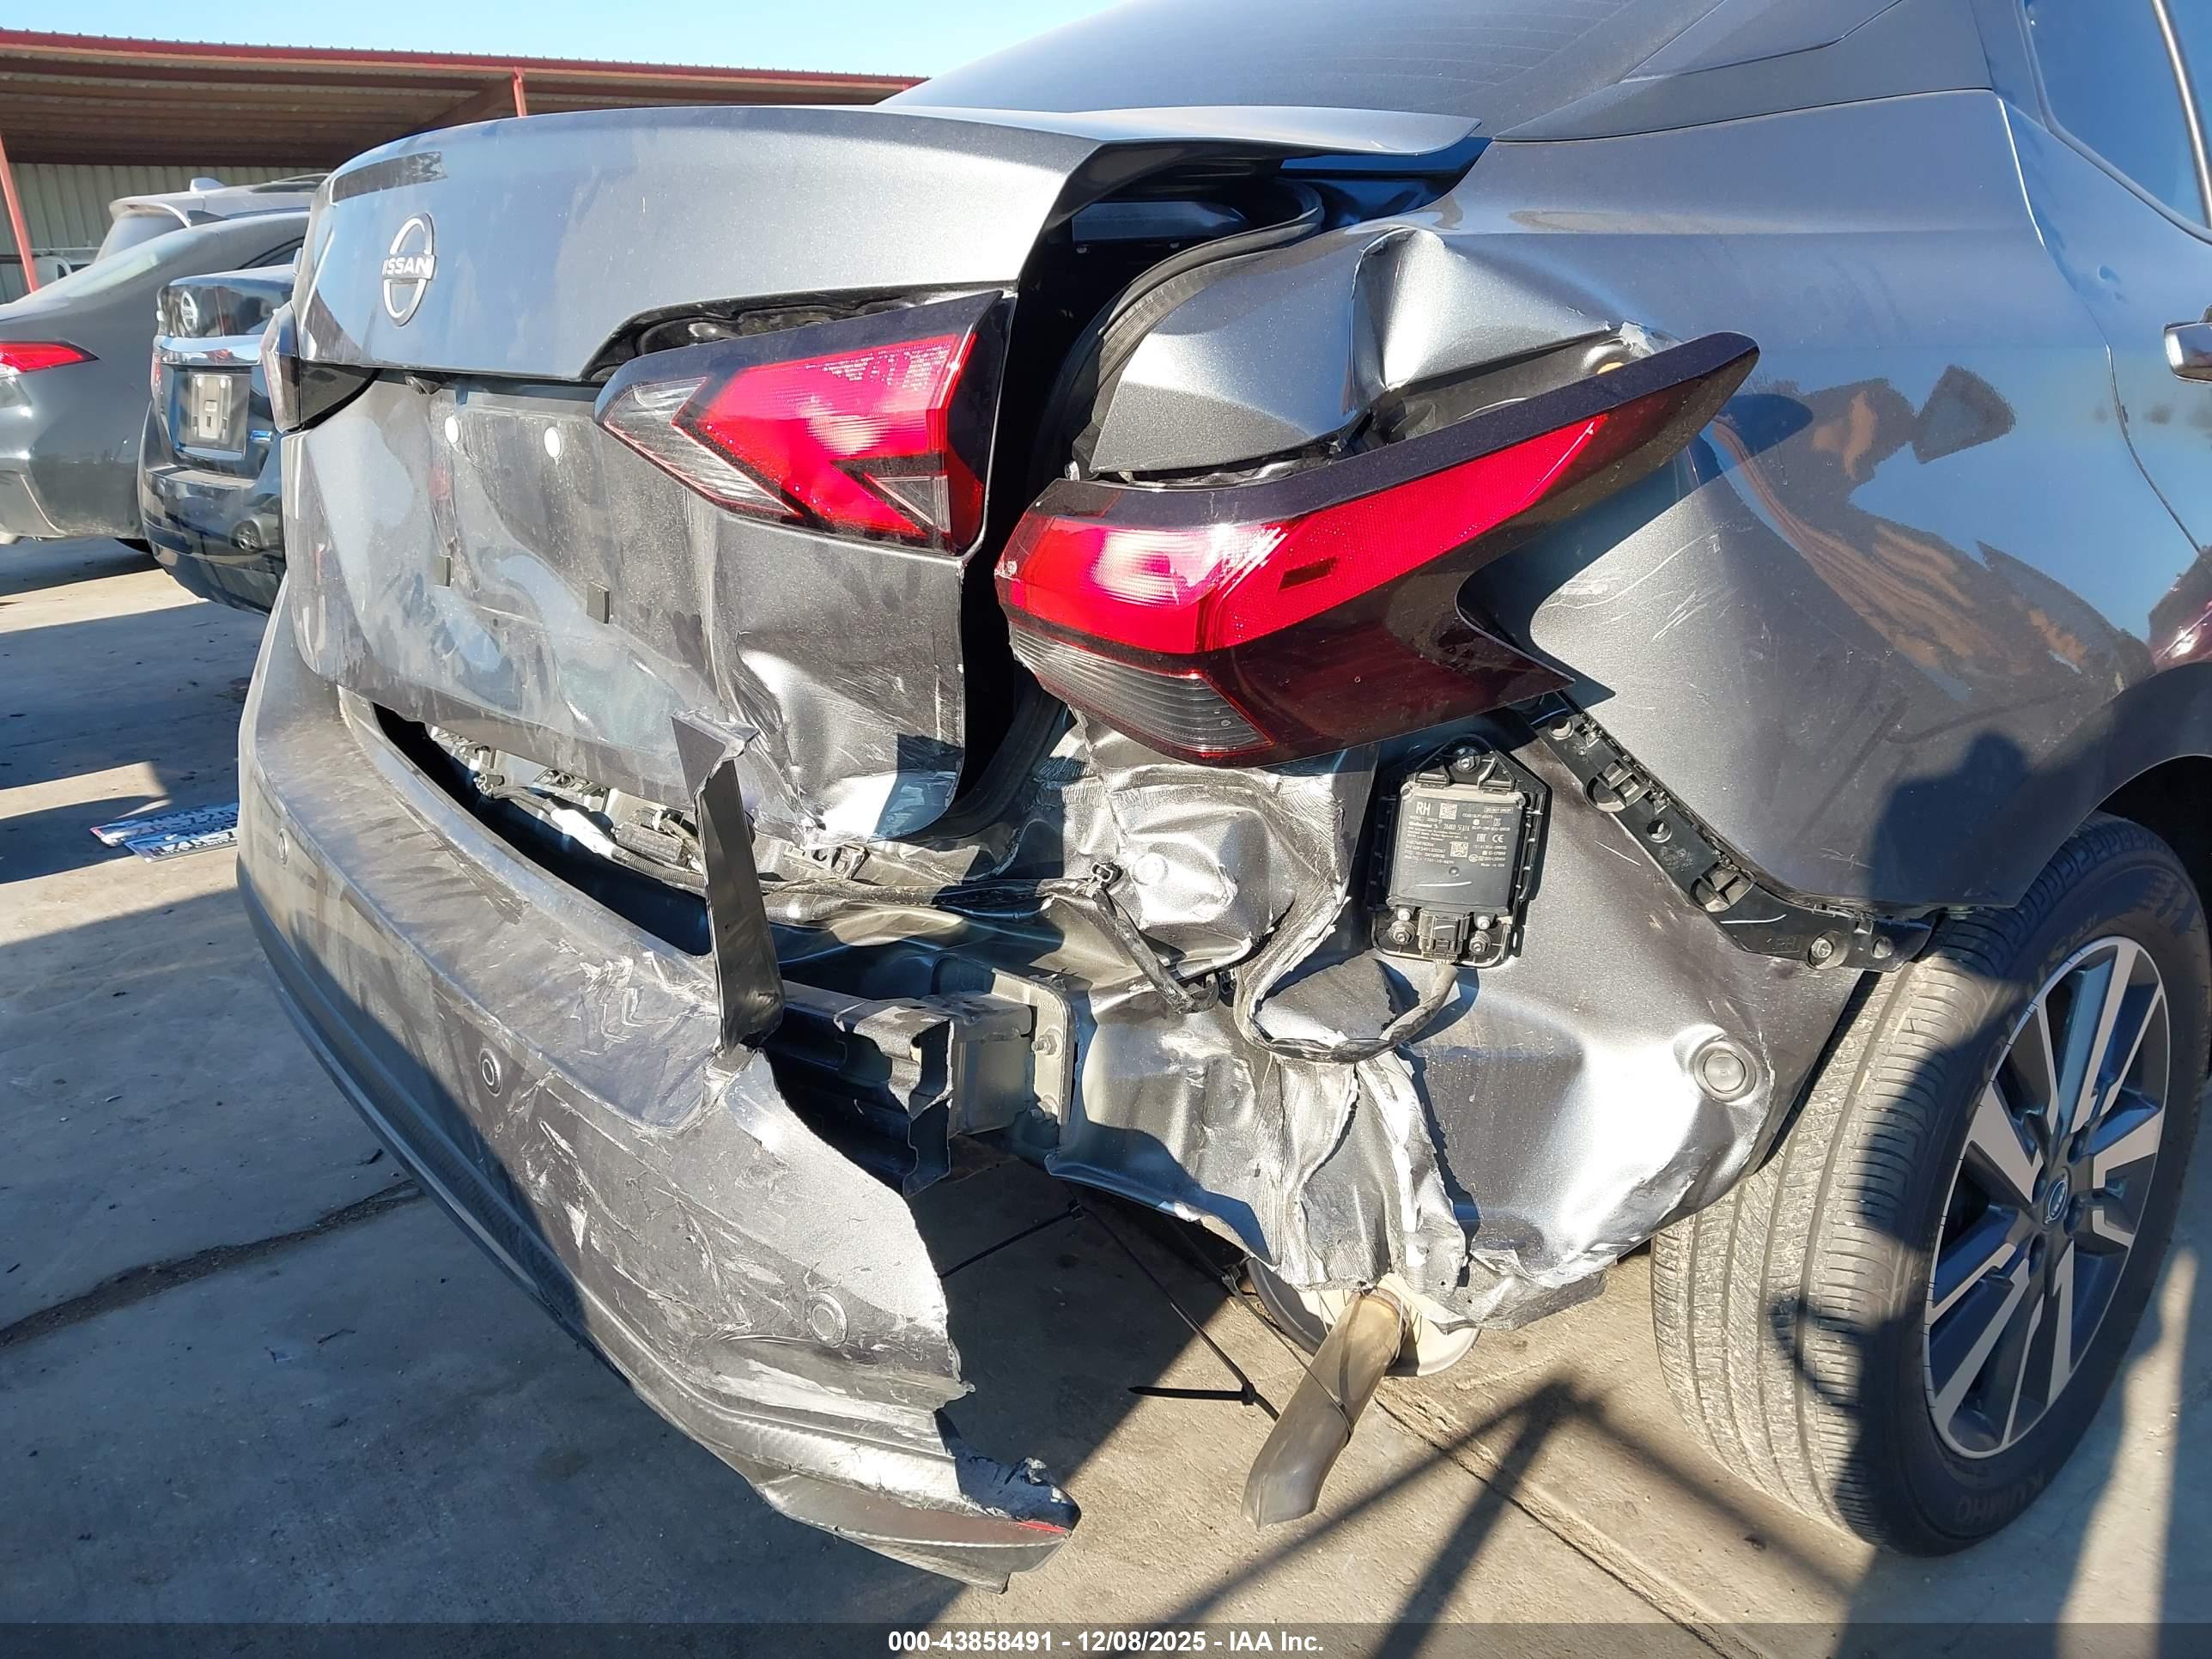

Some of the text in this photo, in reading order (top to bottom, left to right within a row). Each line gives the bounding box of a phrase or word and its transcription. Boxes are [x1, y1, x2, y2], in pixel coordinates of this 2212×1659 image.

[1415, 801, 1431, 817] RH
[1492, 834, 1504, 843] CE
[1954, 1469, 2045, 1525] KUMHO
